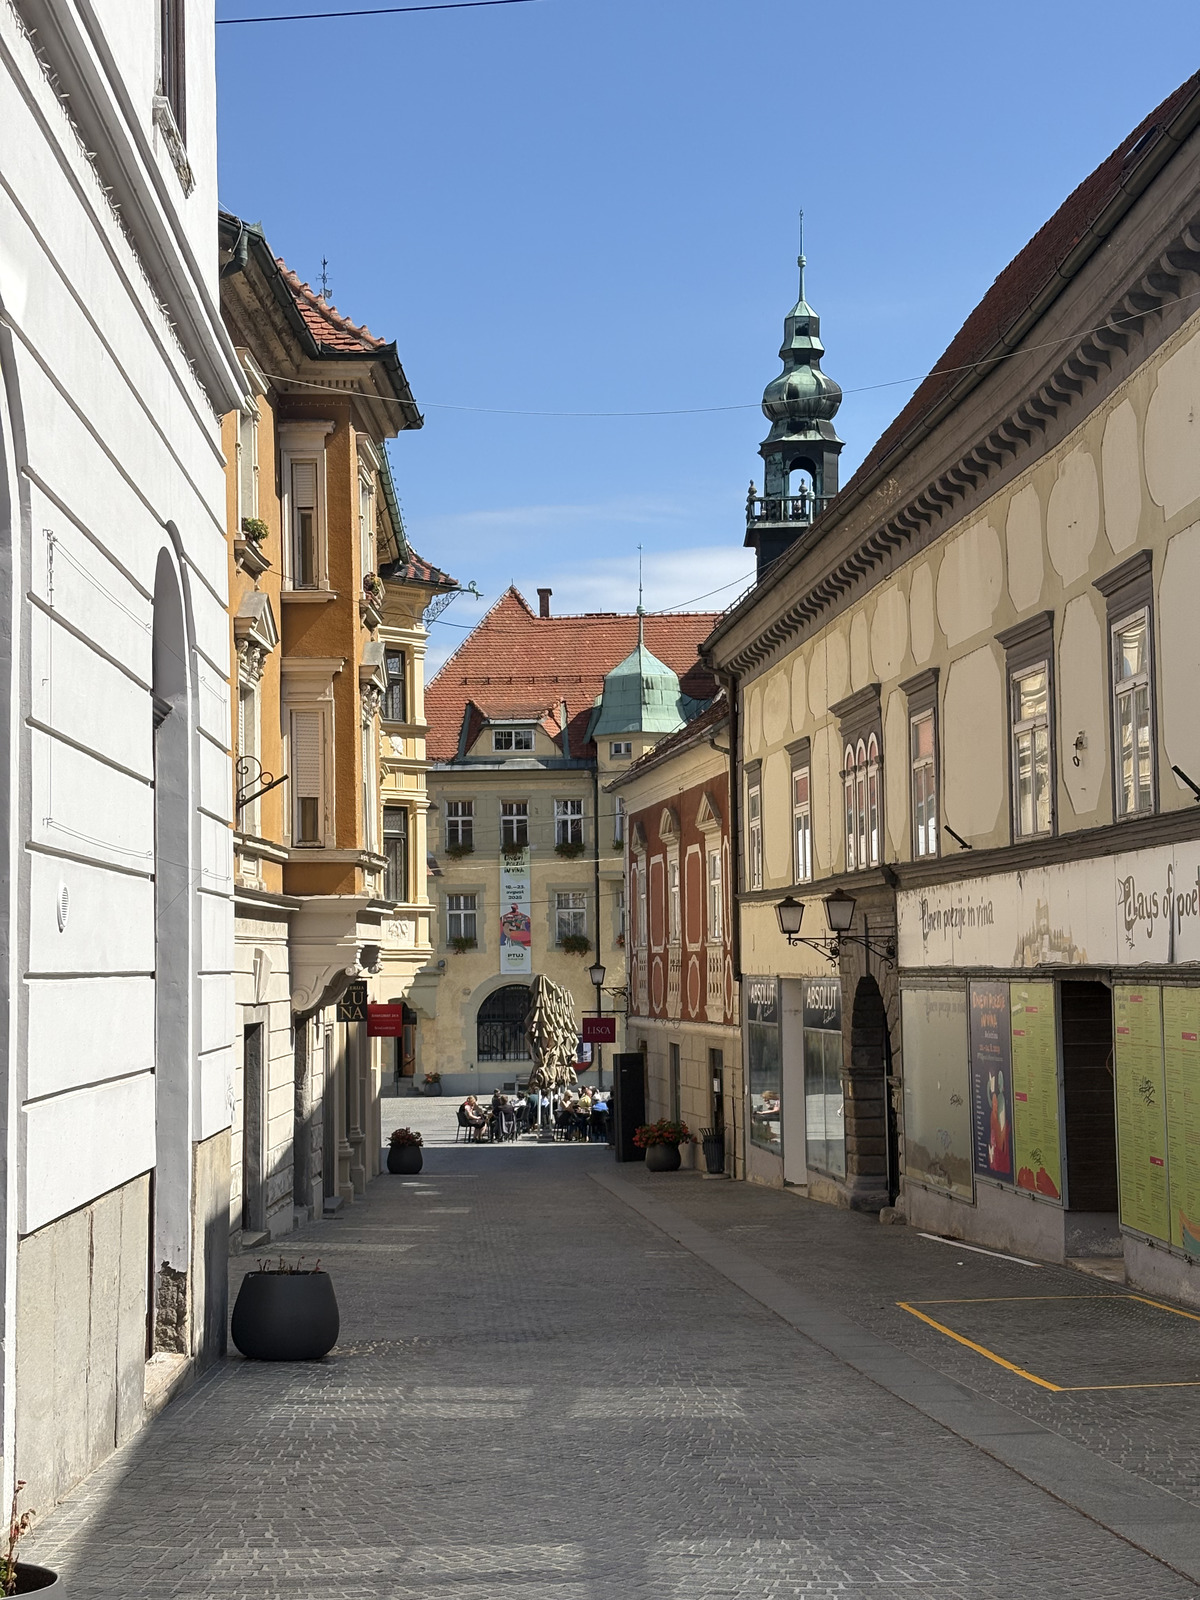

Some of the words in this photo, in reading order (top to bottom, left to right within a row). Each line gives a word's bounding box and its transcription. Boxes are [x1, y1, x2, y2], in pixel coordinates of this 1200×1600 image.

[1163, 863, 1174, 922] of
[976, 896, 995, 930] vina
[750, 983, 775, 1005] ABSOLUT
[806, 986, 837, 1010] ABSOLUT
[340, 1006, 364, 1020] NA
[587, 1026, 611, 1035] LISCA
